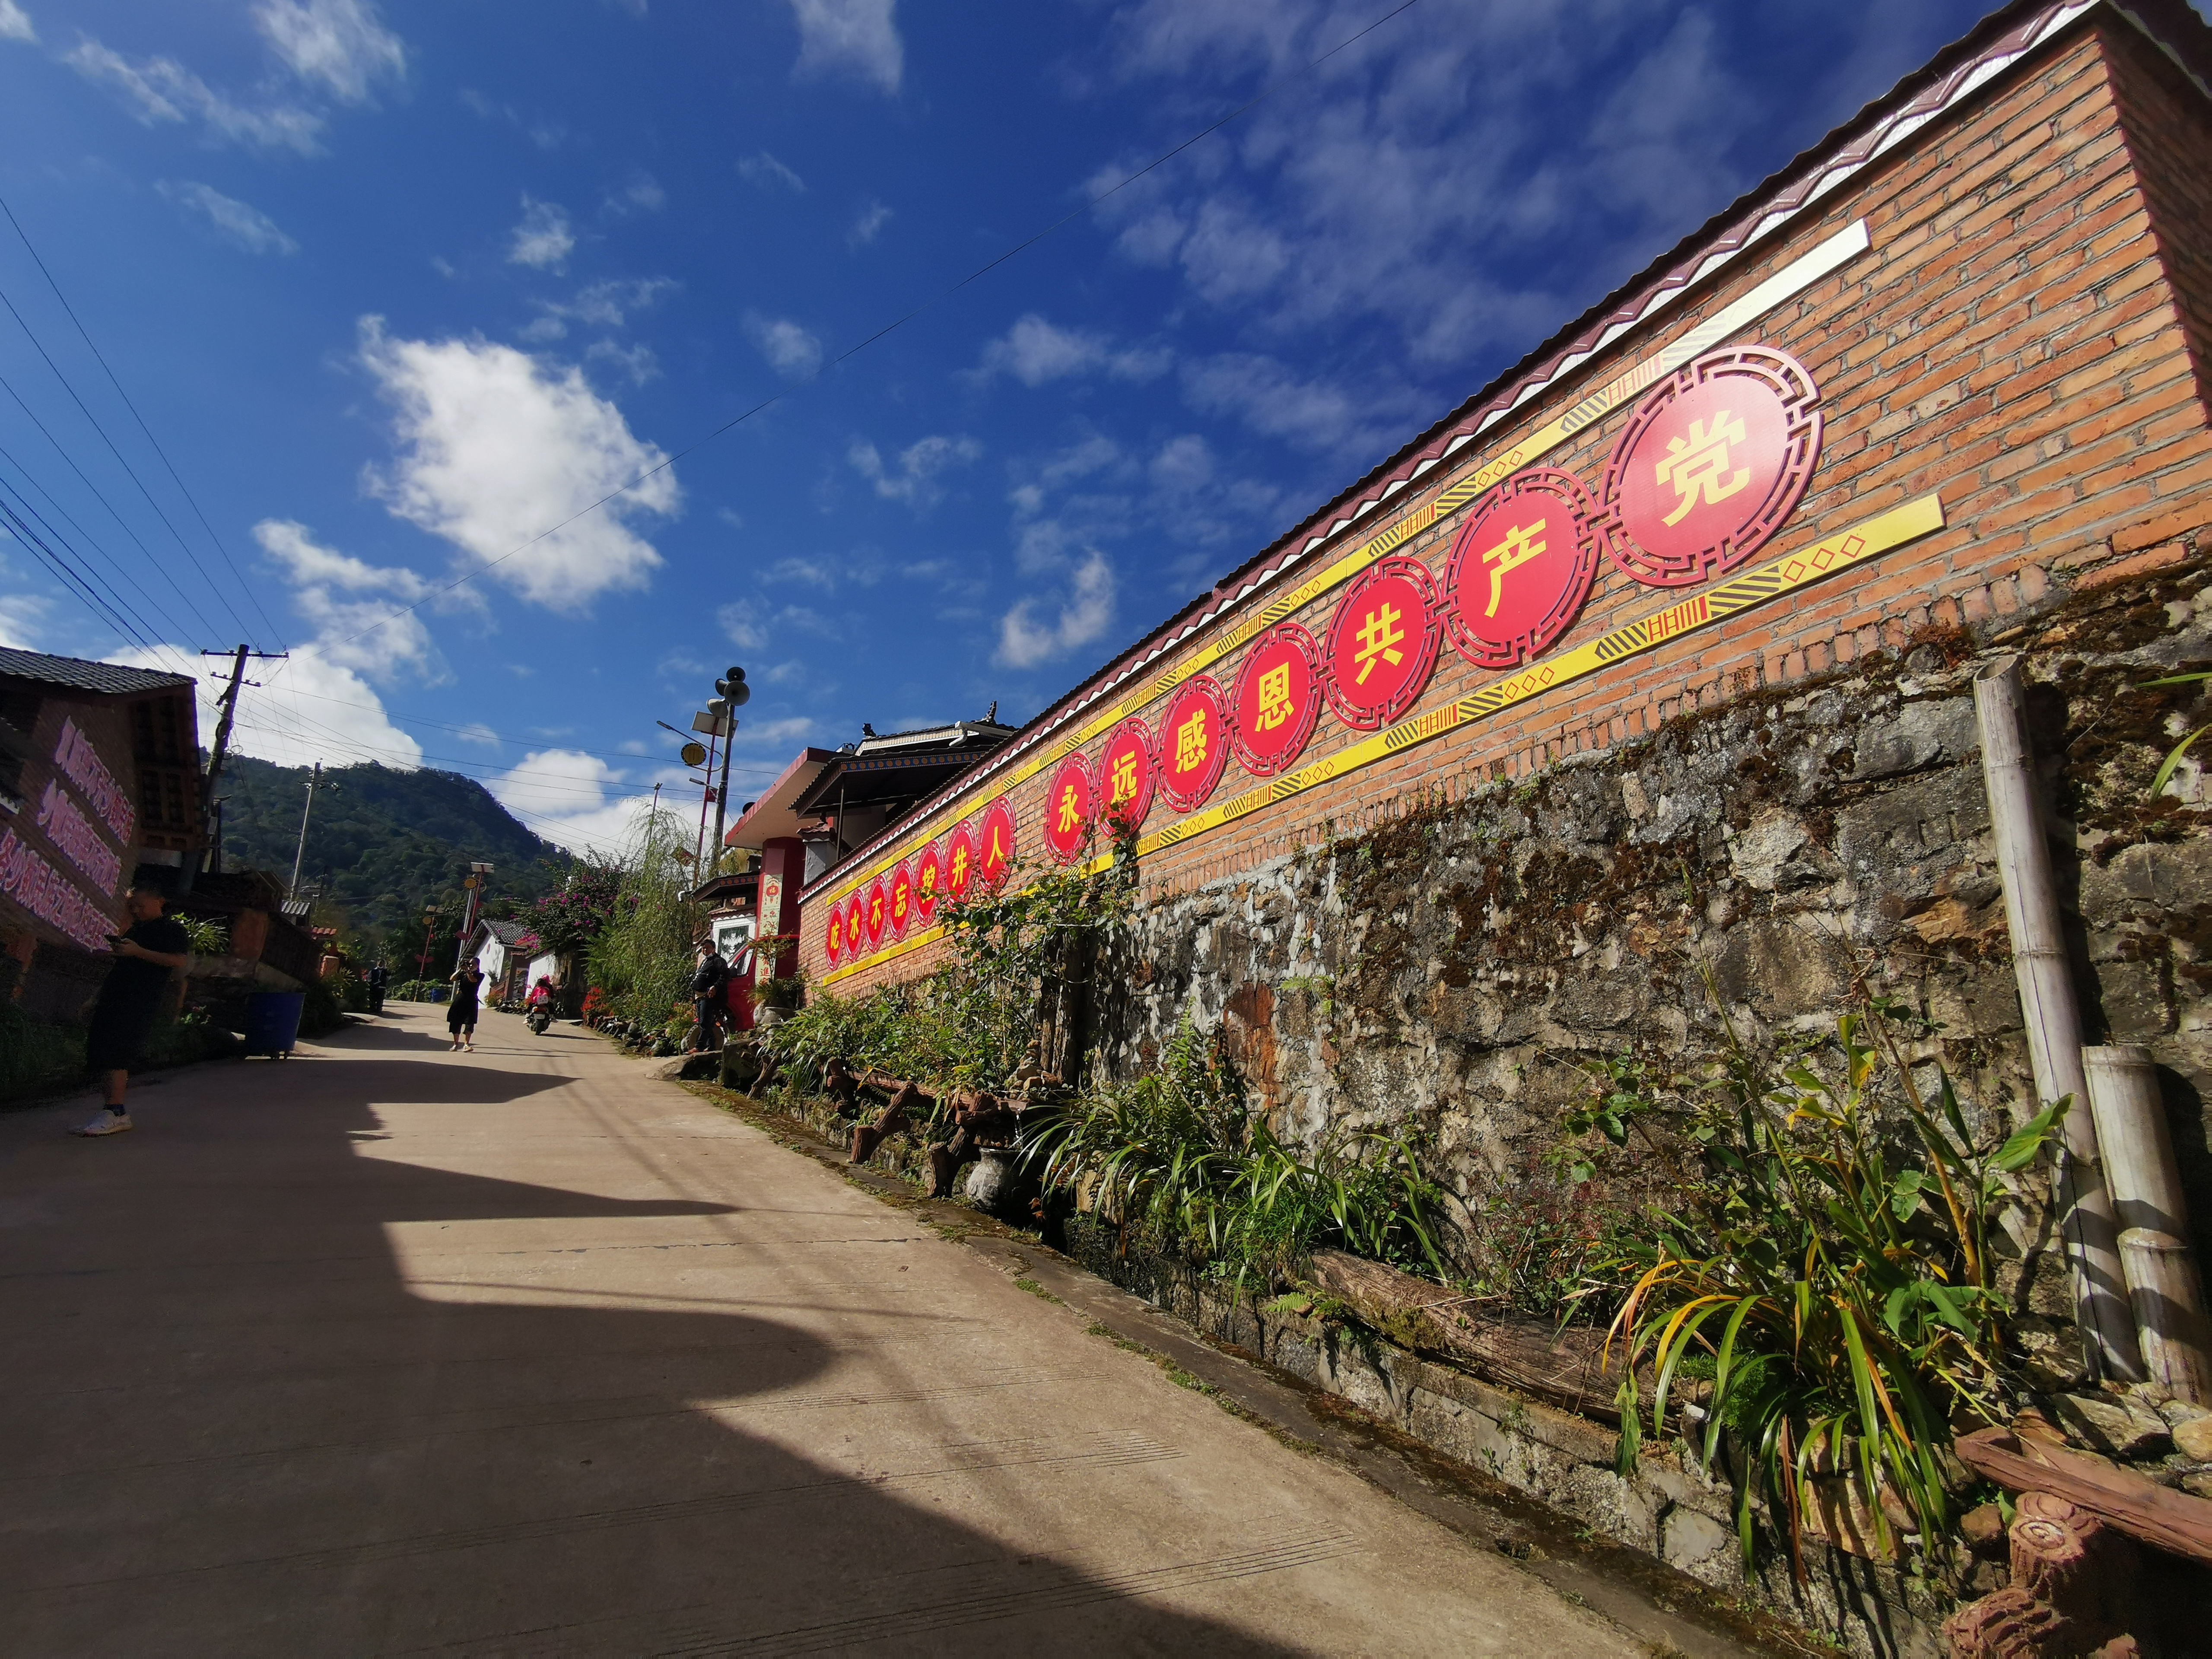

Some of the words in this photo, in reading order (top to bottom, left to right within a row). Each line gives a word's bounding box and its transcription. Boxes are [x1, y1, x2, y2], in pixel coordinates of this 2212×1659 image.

[830, 826, 1004, 949] 吃水不忘挖井人
[1058, 409, 1753, 833] 永远感恩共产党
